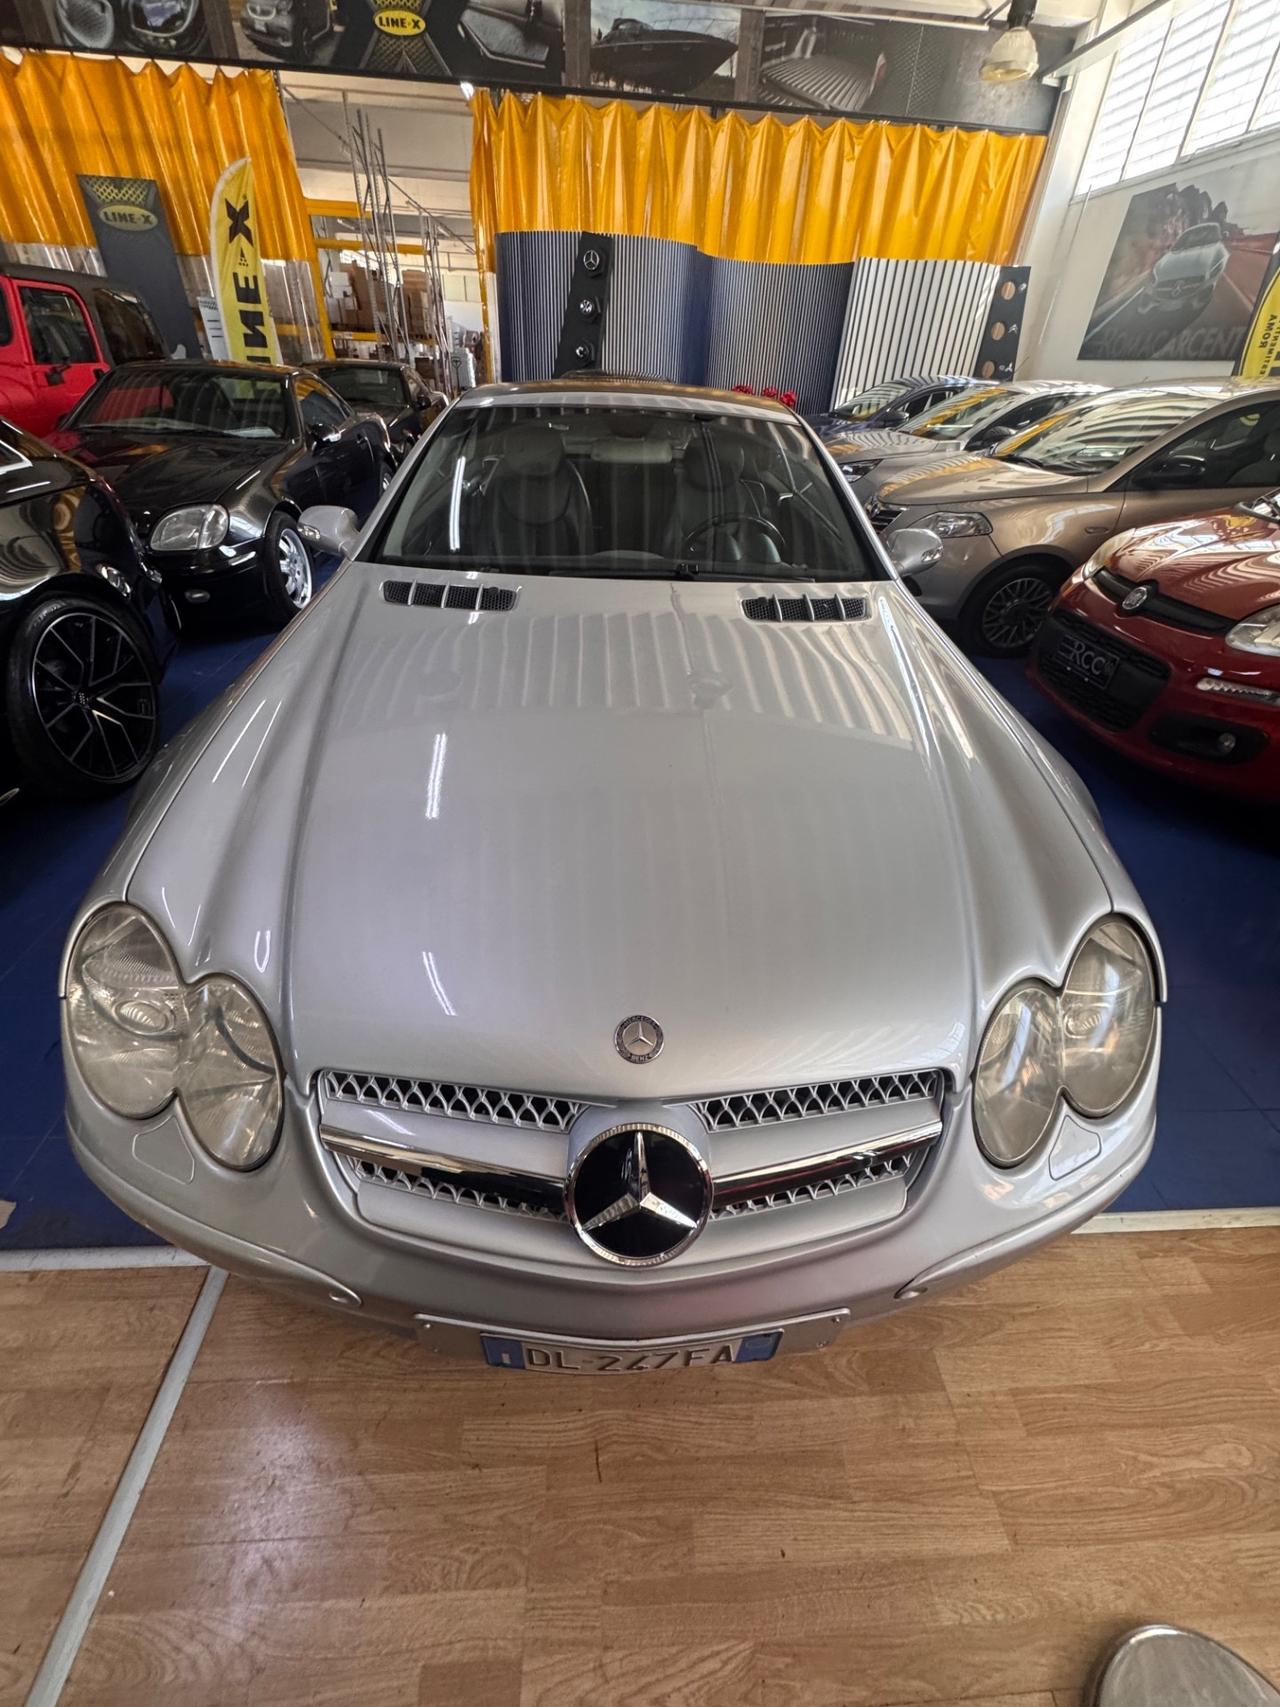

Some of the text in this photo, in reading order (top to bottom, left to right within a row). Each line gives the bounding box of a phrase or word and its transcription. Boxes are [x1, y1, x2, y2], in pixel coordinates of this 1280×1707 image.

[378, 16, 421, 30] LINE-X
[103, 211, 153, 225] LINE-X
[224, 198, 272, 364] INE-X
